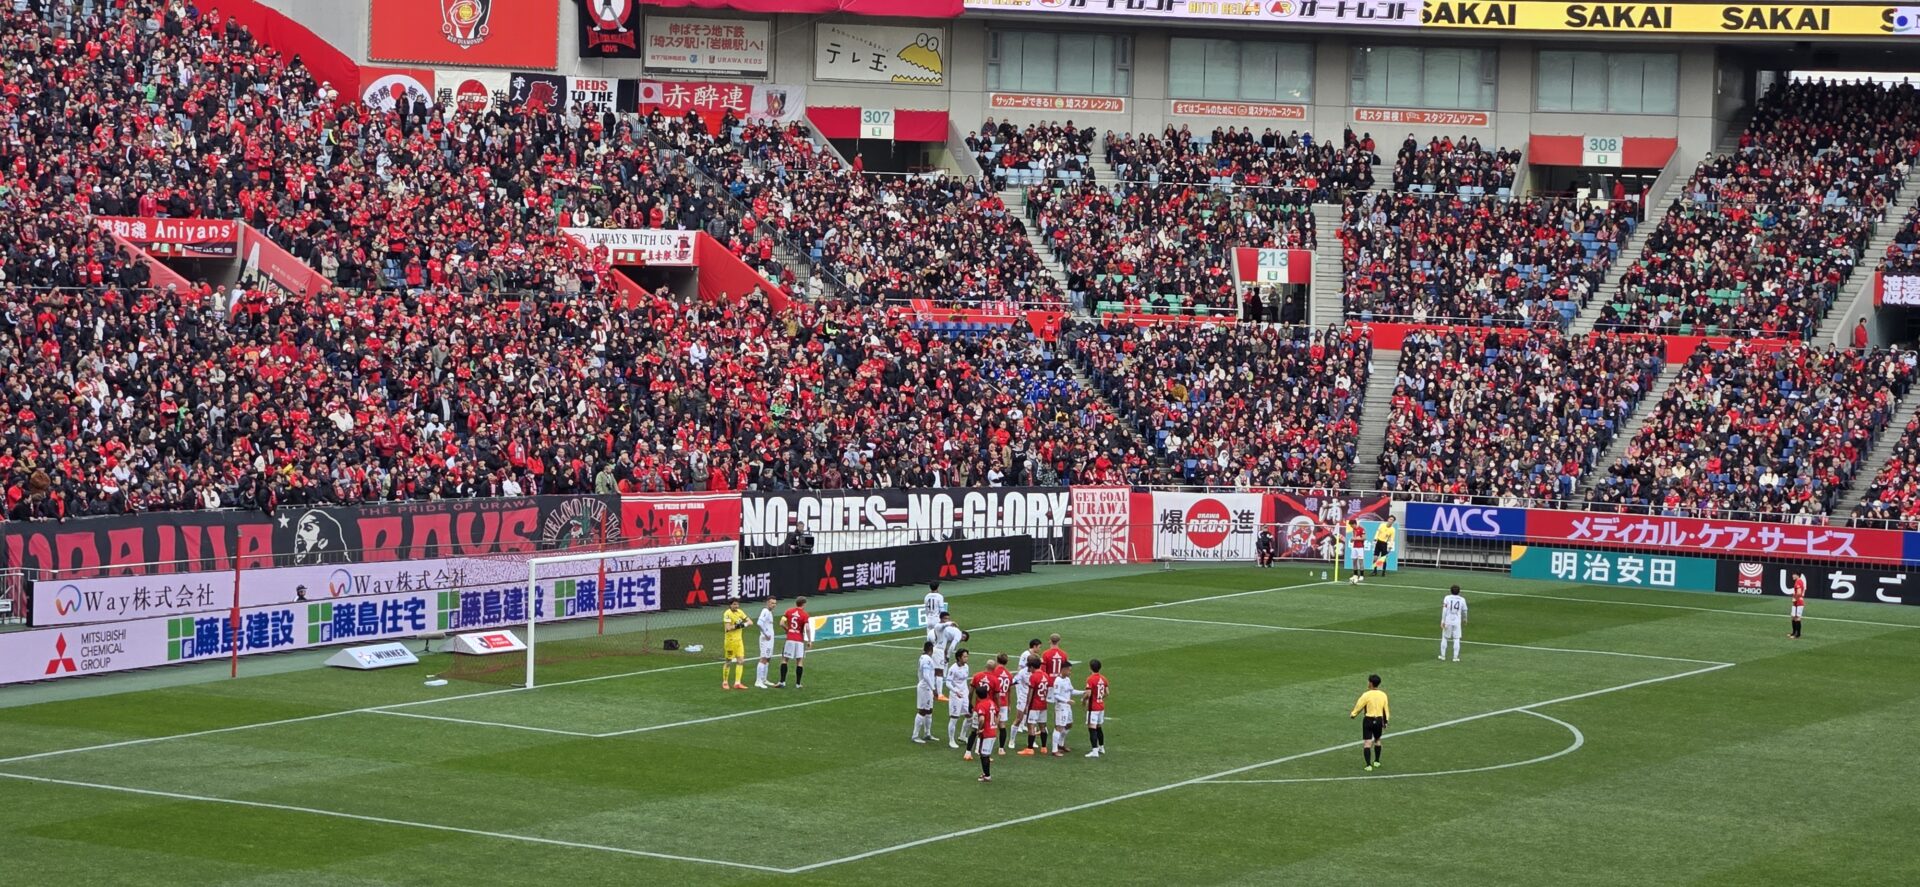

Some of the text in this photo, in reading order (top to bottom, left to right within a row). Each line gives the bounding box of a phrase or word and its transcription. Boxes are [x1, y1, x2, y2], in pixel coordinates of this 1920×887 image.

[1299, 1, 1415, 19] オートレント
[1422, 3, 1516, 25] SAKAI
[1565, 4, 1672, 28] SAKAI
[1721, 7, 1830, 31] SAKAI
[669, 23, 745, 38] 伸ばそう地下鉄
[827, 42, 888, 73] テレ玉
[576, 79, 608, 91] REDS
[571, 90, 614, 102] TO THE
[664, 83, 747, 113] 赤酔連
[996, 96, 1053, 108] サッカーができる!
[1090, 100, 1119, 110] レンタル
[863, 110, 891, 124] 307
[1424, 112, 1483, 124] スタジアムツアー
[1589, 138, 1617, 152] 308
[590, 232, 673, 246] ALWAYS WITH US
[1258, 251, 1288, 267] 213
[1075, 490, 1128, 502] GET GOAL
[359, 499, 537, 516] THE PRIDE OF URAWA
[1076, 502, 1128, 515] URAWA
[742, 496, 789, 547] NO
[797, 495, 888, 538] GUTS
[908, 493, 954, 545] NO
[963, 491, 1070, 541] GLORY
[1160, 508, 1255, 535] 爆 進
[1188, 519, 1229, 533] REDS
[1431, 506, 1501, 536] MCS
[1567, 516, 1859, 557] メディカル・ケア・サービス
[1171, 548, 1240, 558] RISING REDS
[961, 549, 1011, 575] 三菱地所
[1551, 551, 1676, 587] 明治安田
[842, 560, 896, 587] 三菱地所
[1737, 587, 1762, 595] ICHIGO
[1780, 569, 1907, 603] いちご
[83, 583, 215, 616] Way株式会社
[577, 576, 656, 613] 藤島住宅
[927, 598, 935, 611] 41
[1450, 600, 1460, 611] 14
[333, 596, 426, 638] 藤島住宅
[791, 616, 798, 630] 5
[81, 629, 127, 644] MITSUBISHI
[195, 609, 295, 656] 藤島建設
[81, 643, 125, 658] CHEMICAL
[373, 648, 407, 659] WINNER
[80, 657, 111, 671] GROUP
[1052, 658, 1062, 675] 11
